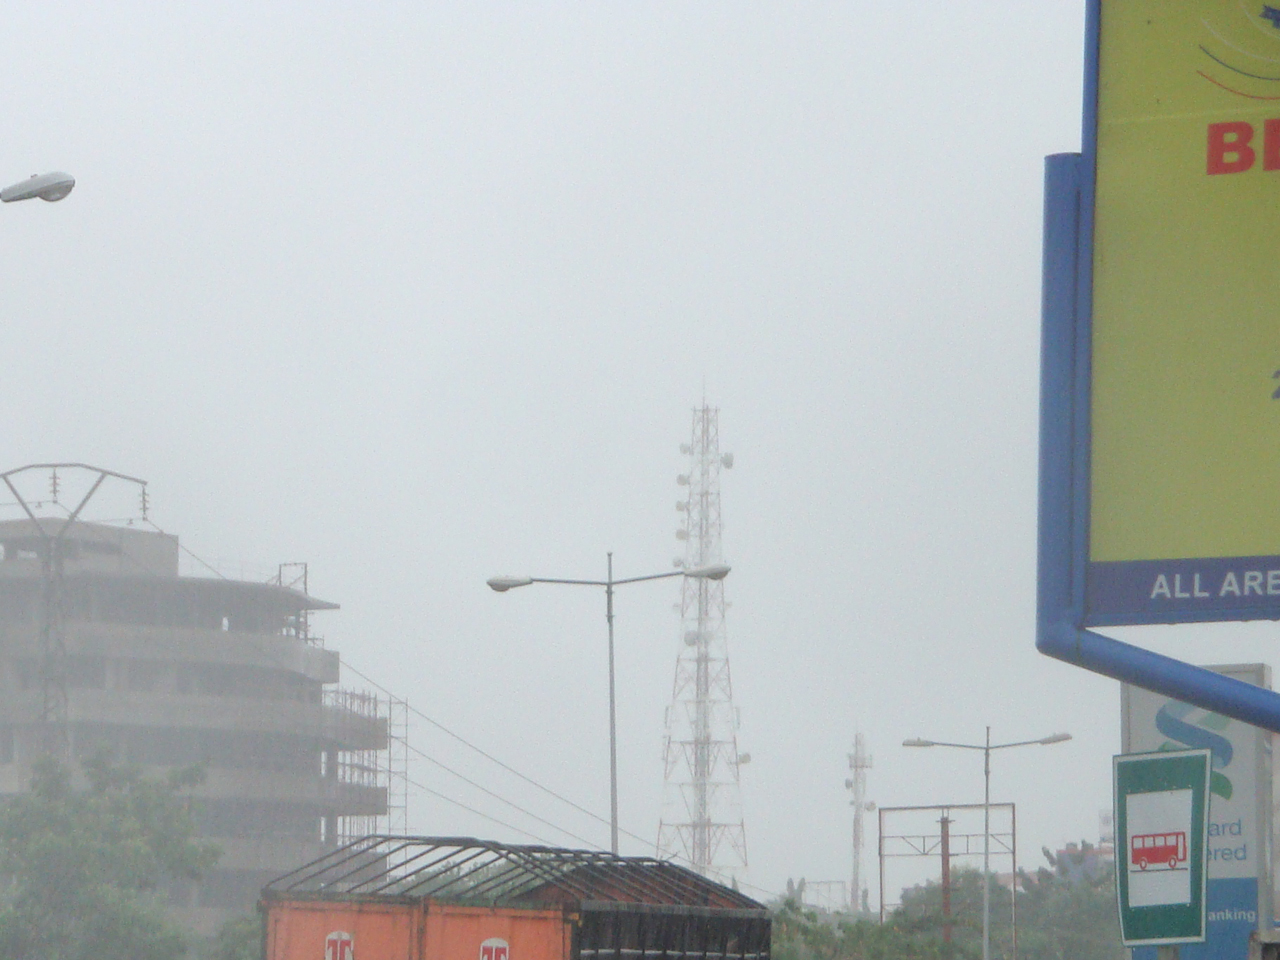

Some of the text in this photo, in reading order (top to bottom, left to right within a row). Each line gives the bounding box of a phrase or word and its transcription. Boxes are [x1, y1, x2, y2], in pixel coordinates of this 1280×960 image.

[1206, 118, 1280, 175] B
[1150, 569, 1280, 599] ALL ARE
[1208, 820, 1242, 837] ard
[1208, 909, 1256, 922] anking
